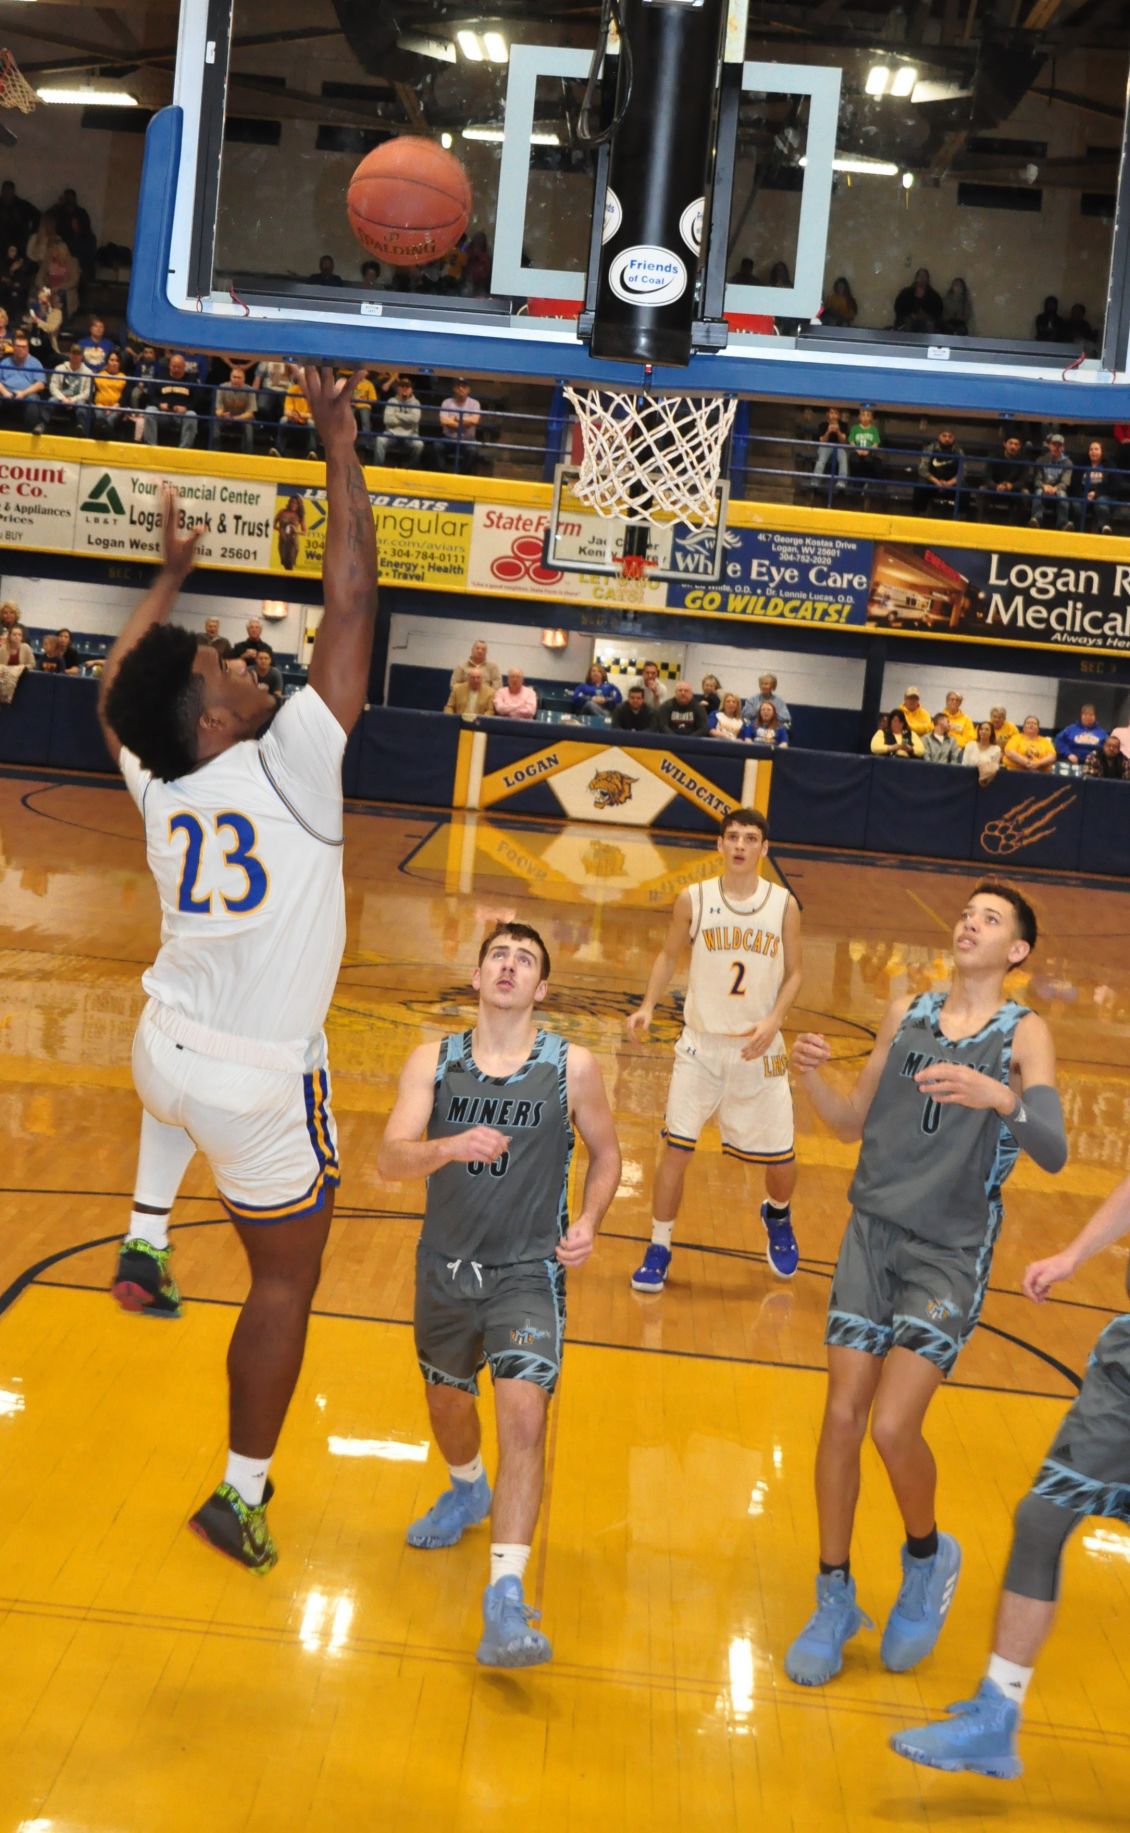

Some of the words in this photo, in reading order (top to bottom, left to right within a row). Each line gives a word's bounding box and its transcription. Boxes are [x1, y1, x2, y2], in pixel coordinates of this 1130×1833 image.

[629, 259, 679, 274] Friends
[628, 274, 638, 283] of
[641, 276, 665, 285] Coal
[16, 482, 47, 498] Co.
[131, 477, 157, 496] Your
[220, 486, 261, 506] Center
[15, 503, 71, 517] Appliances
[392, 497, 449, 511] CATS
[129, 504, 164, 532] Loga
[217, 512, 227, 534] &
[233, 514, 270, 538] Trust
[483, 510, 533, 531] State
[87, 534, 125, 549] Logan
[129, 538, 160, 552] West
[220, 547, 258, 560] 25601
[771, 543, 799, 553] Logan,
[801, 546, 815, 554] WV
[817, 547, 840, 557] 25601
[773, 534, 803, 545] George
[805, 537, 833, 547] Kostas
[835, 540, 857, 549] Drive
[380, 558, 417, 571] Energy
[428, 562, 464, 574] Health
[392, 569, 424, 581] Travel
[675, 551, 741, 578] Whe
[750, 558, 799, 587] Eye
[808, 565, 868, 590] Care
[988, 553, 1100, 600] Logan
[766, 588, 778, 596] Dr.
[780, 590, 807, 599] Lonnie
[684, 590, 722, 610] GO
[726, 593, 853, 623] WILDCATS!
[1051, 632, 1103, 647] Always
[503, 754, 560, 788] LOGAN
[659, 758, 732, 818] WILDCATS
[167, 808, 270, 918] 23
[701, 926, 780, 959] WILDCATS
[728, 960, 748, 998] 2
[446, 1096, 547, 1128] MINERS
